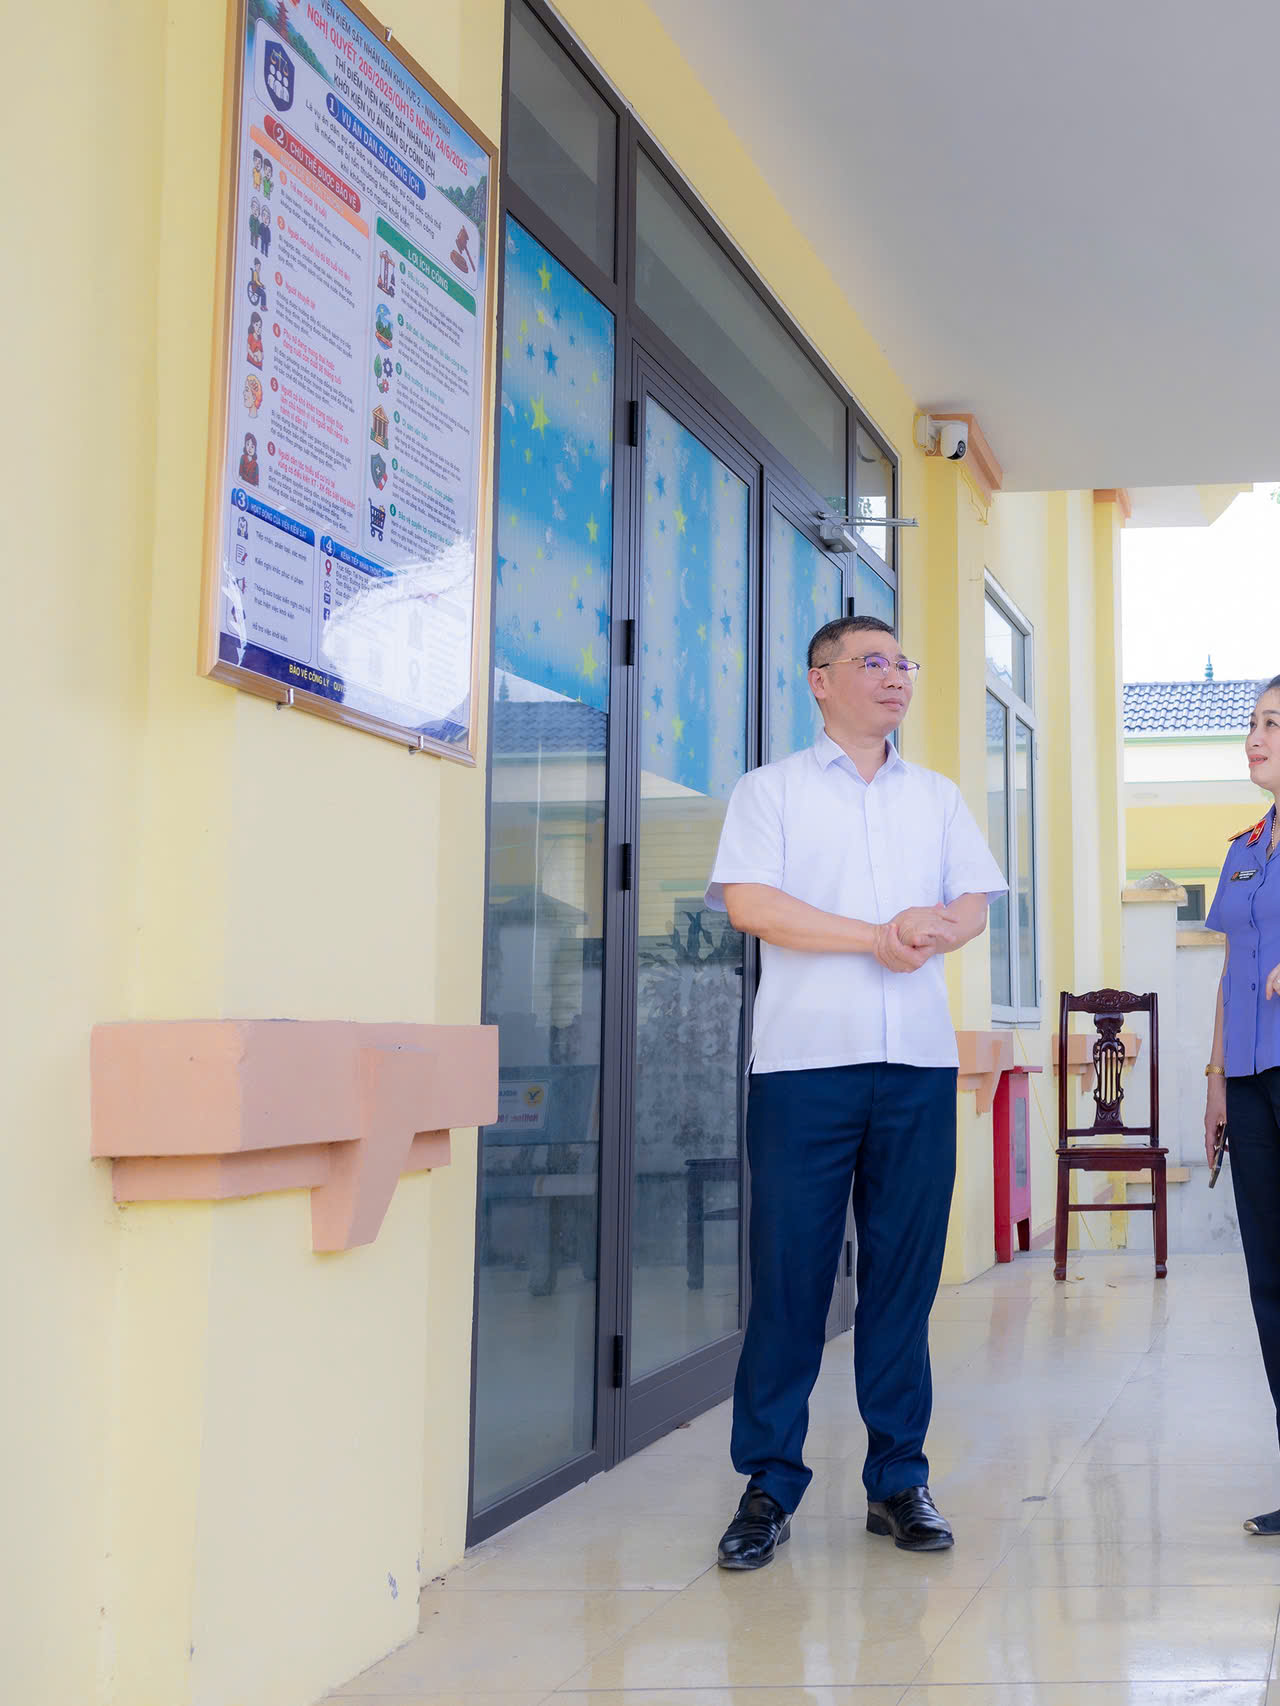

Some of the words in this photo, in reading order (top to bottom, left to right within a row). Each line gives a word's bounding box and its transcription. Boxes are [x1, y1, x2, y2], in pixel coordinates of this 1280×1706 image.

[306, 4, 328, 38] NGHỊ
[330, 27, 356, 62] QUYẾT
[358, 57, 414, 121] 205/2025/QH15
[415, 114, 434, 141] NGÀY
[435, 135, 467, 175] 24/6/2025
[329, 97, 334, 113] 1
[341, 109, 351, 129] VỤ
[352, 118, 362, 138] ÁN
[363, 131, 377, 153] DÂN
[378, 145, 388, 163] SỰ
[389, 152, 407, 181] CÔNG
[408, 171, 419, 192] ÍCH
[408, 249, 418, 264] LỢI
[419, 257, 429, 274] ÍCH
[431, 269, 448, 290] CÔNG
[238, 491, 244, 507] 3
[325, 540, 332, 553] 4
[289, 662, 300, 676] BẢO
[301, 667, 307, 679] VỆ
[308, 671, 322, 684] CÔNG
[323, 676, 329, 686] LÝ
